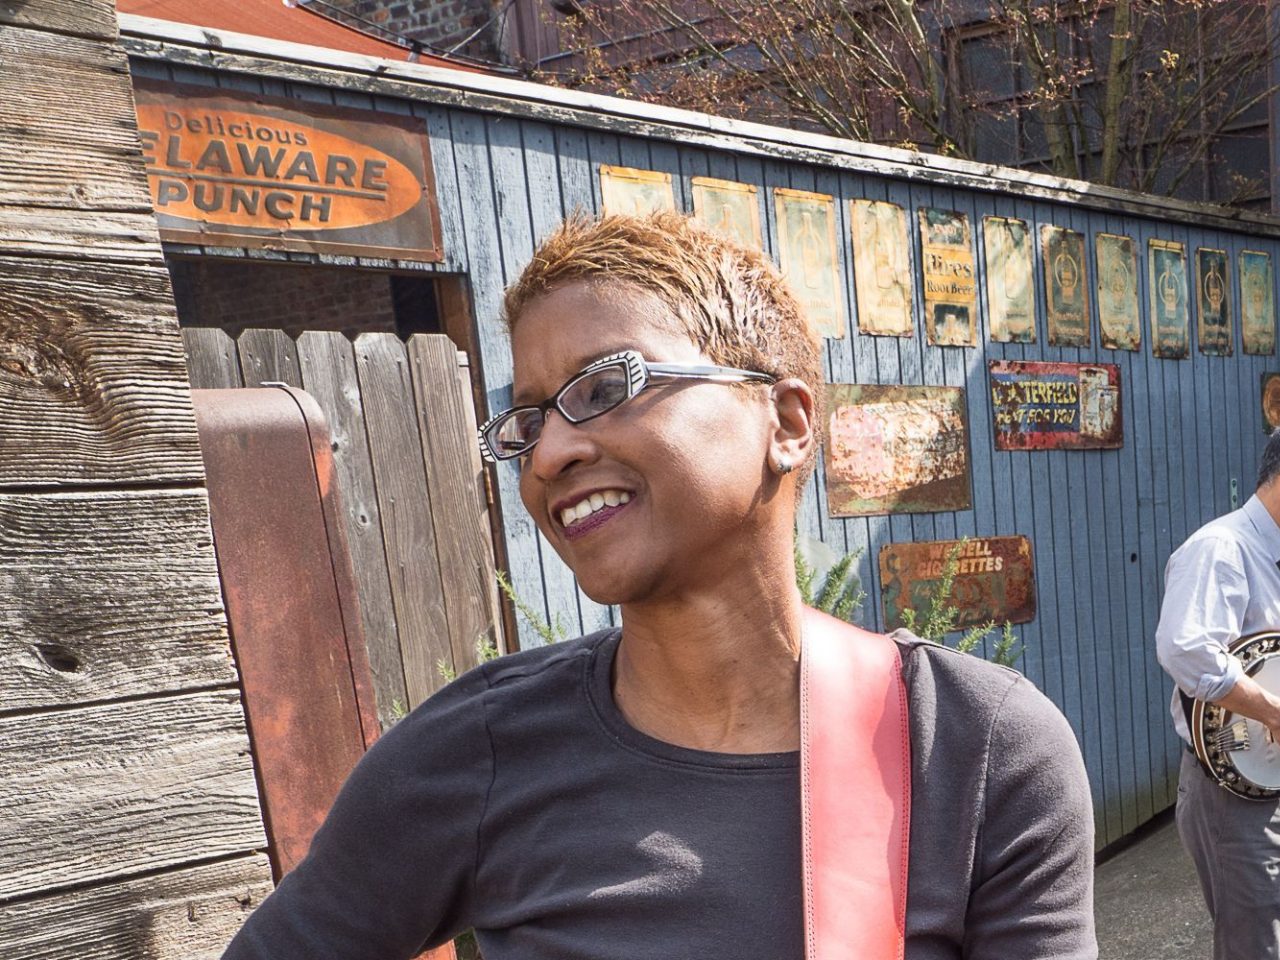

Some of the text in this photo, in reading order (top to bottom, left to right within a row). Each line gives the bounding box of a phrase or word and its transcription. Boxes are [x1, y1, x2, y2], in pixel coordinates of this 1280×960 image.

[165, 110, 307, 146] Delicious
[141, 130, 388, 191] ELAWARE
[157, 179, 333, 222] PUNCH
[918, 556, 1004, 577] CIGRETTES
